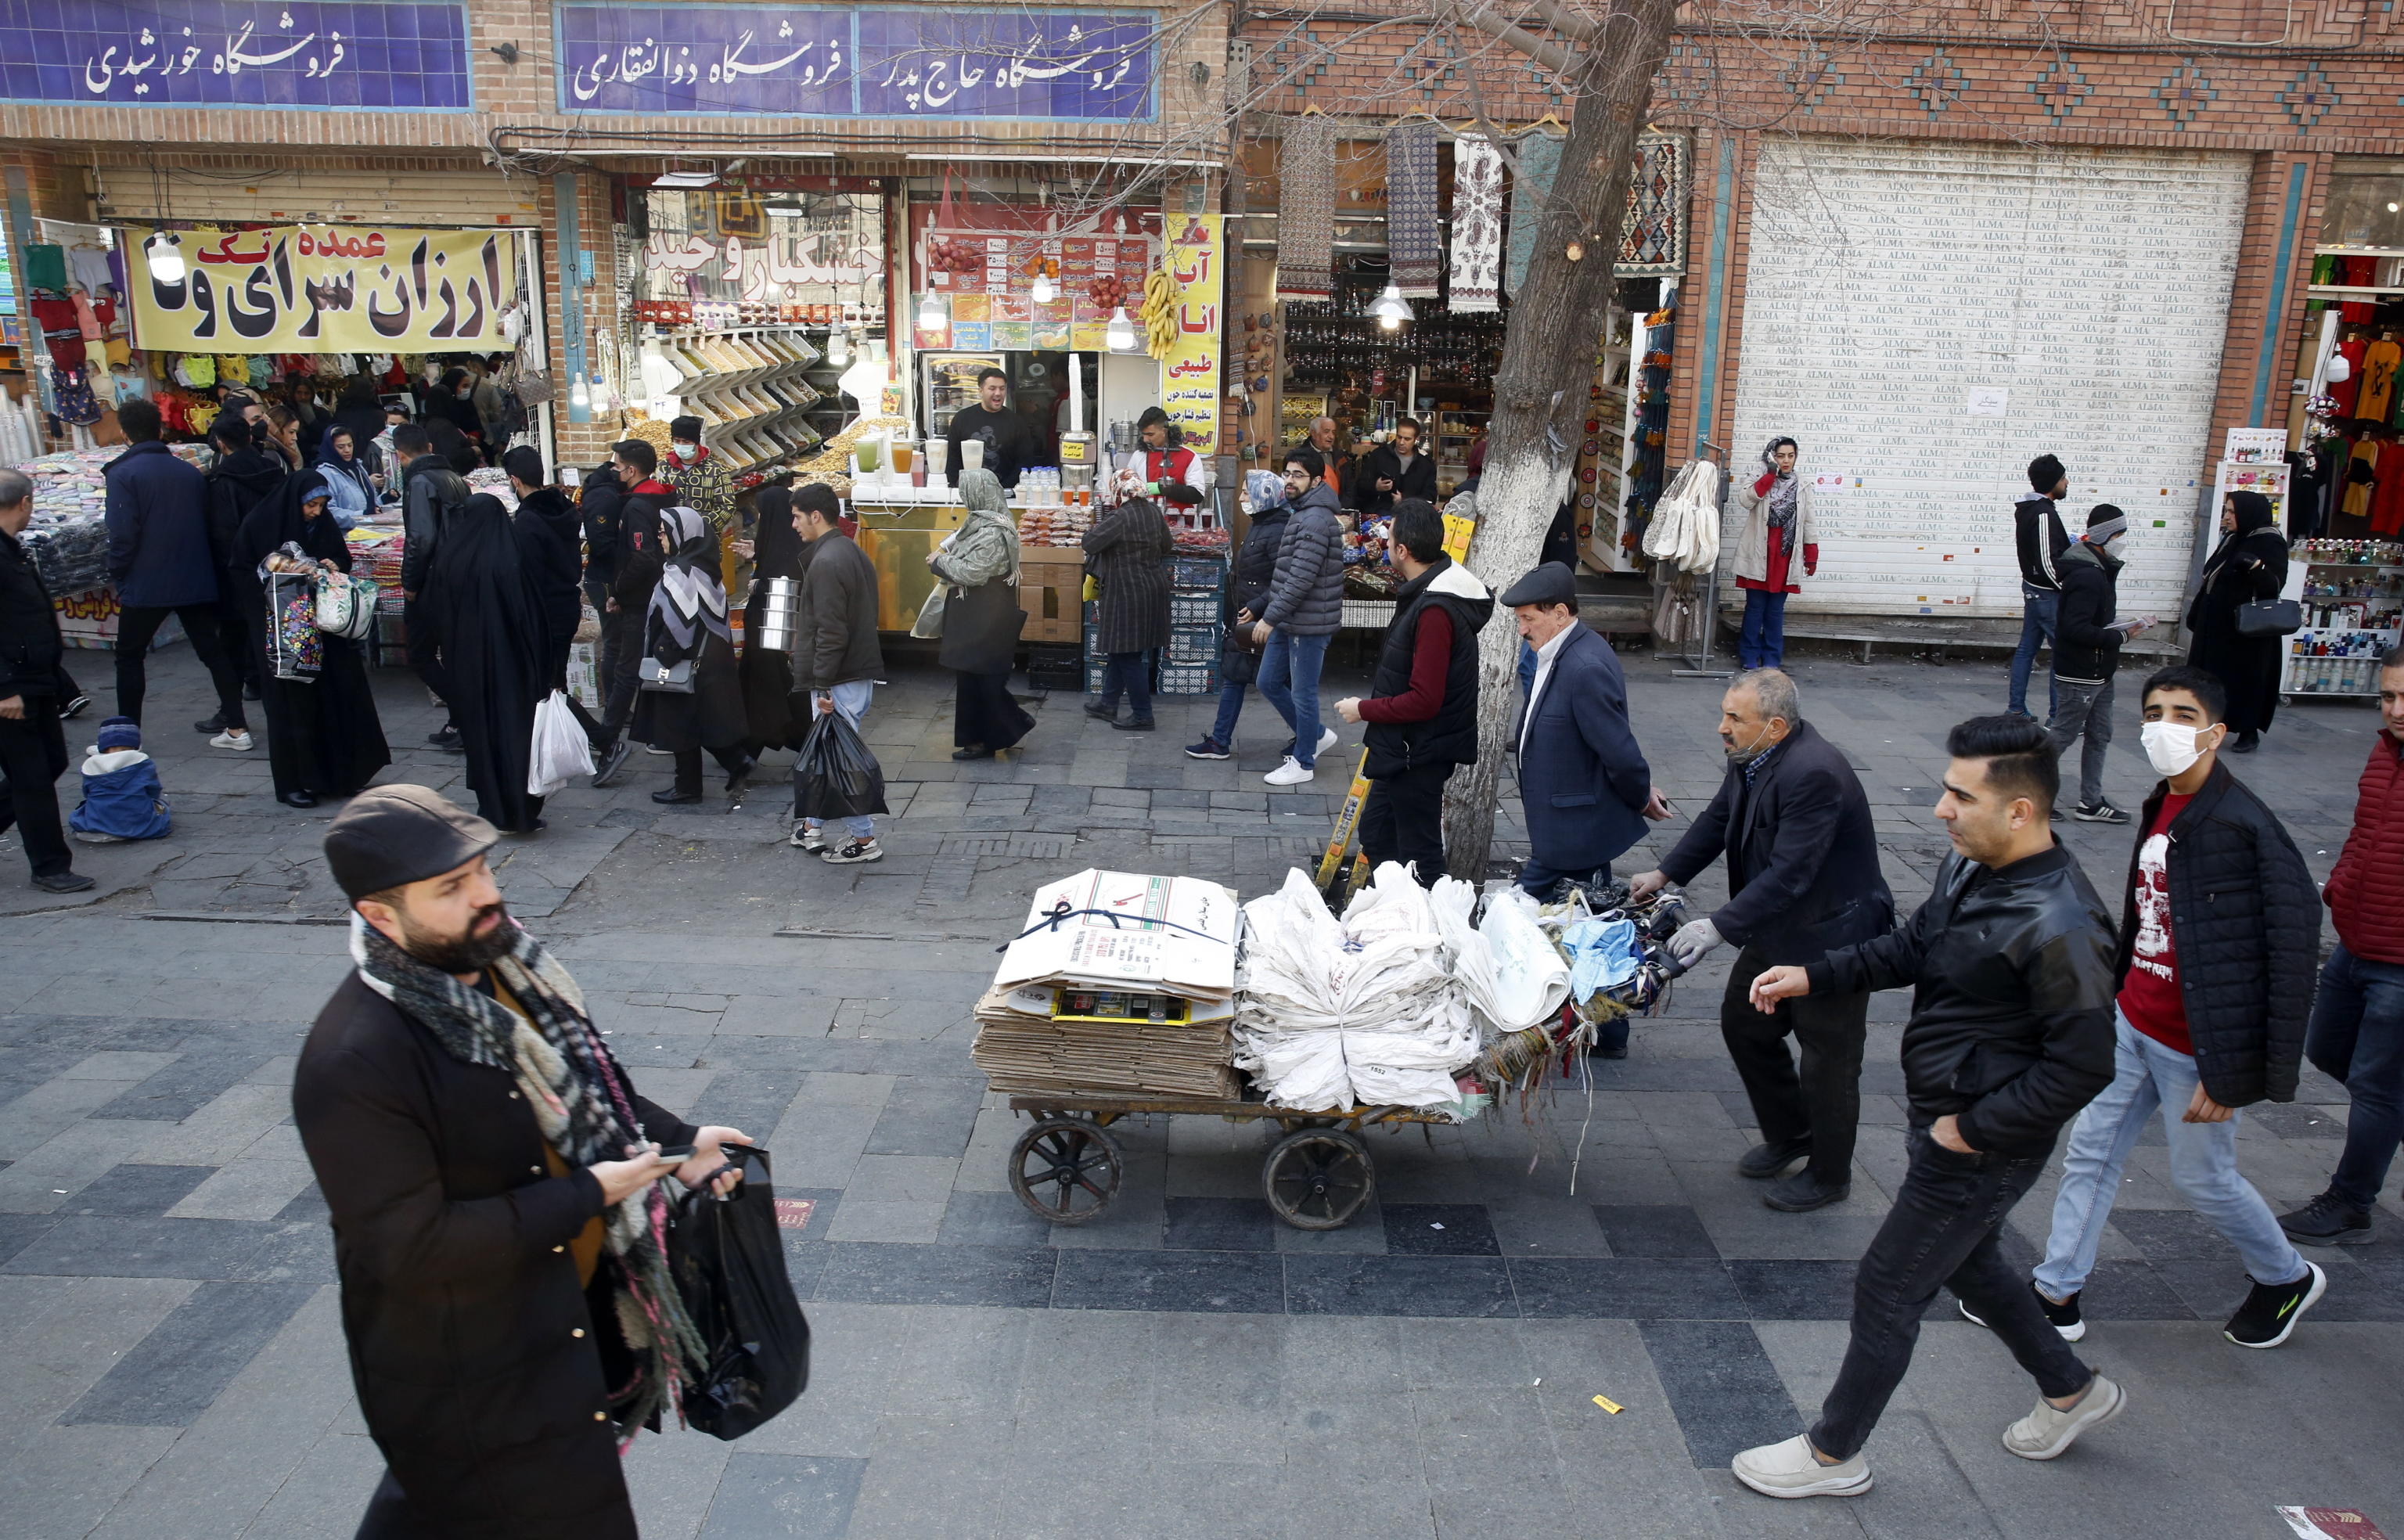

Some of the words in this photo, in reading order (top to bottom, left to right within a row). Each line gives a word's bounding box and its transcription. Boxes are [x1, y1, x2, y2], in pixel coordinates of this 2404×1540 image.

[210, 11, 345, 78] فروشگاه
[85, 26, 202, 94] خورشیدی
[708, 20, 842, 86] فروشگاه
[994, 24, 1132, 92] فروشگاه
[572, 37, 699, 101] ذوالفقاری
[2136, 227, 2163, 236] ALMA
[196, 231, 273, 264] تک
[297, 231, 387, 259] عمده
[2089, 236, 2116, 245] ALMA
[743, 231, 884, 302] خشکبار
[1173, 250, 1212, 291] آب
[1920, 263, 1947, 272] ALMA
[1973, 265, 2000, 274] ALMA
[2132, 272, 2159, 280] ALMA
[226, 236, 354, 339] سرای
[365, 234, 498, 339] ارزان
[1036, 300, 1059, 308] انر
[1876, 306, 1903, 315] ALMA
[2035, 312, 2062, 321] ALMA
[2069, 324, 2096, 333] ALMA
[2121, 326, 2149, 335] ALMA
[1168, 353, 1212, 380] طبیعی
[1883, 362, 1910, 370] ALMA
[1167, 387, 1180, 402] خون
[1198, 388, 1214, 402] تصفیه
[1196, 408, 1211, 423] تنظیم
[1369, 1066, 1386, 1076] 1552
